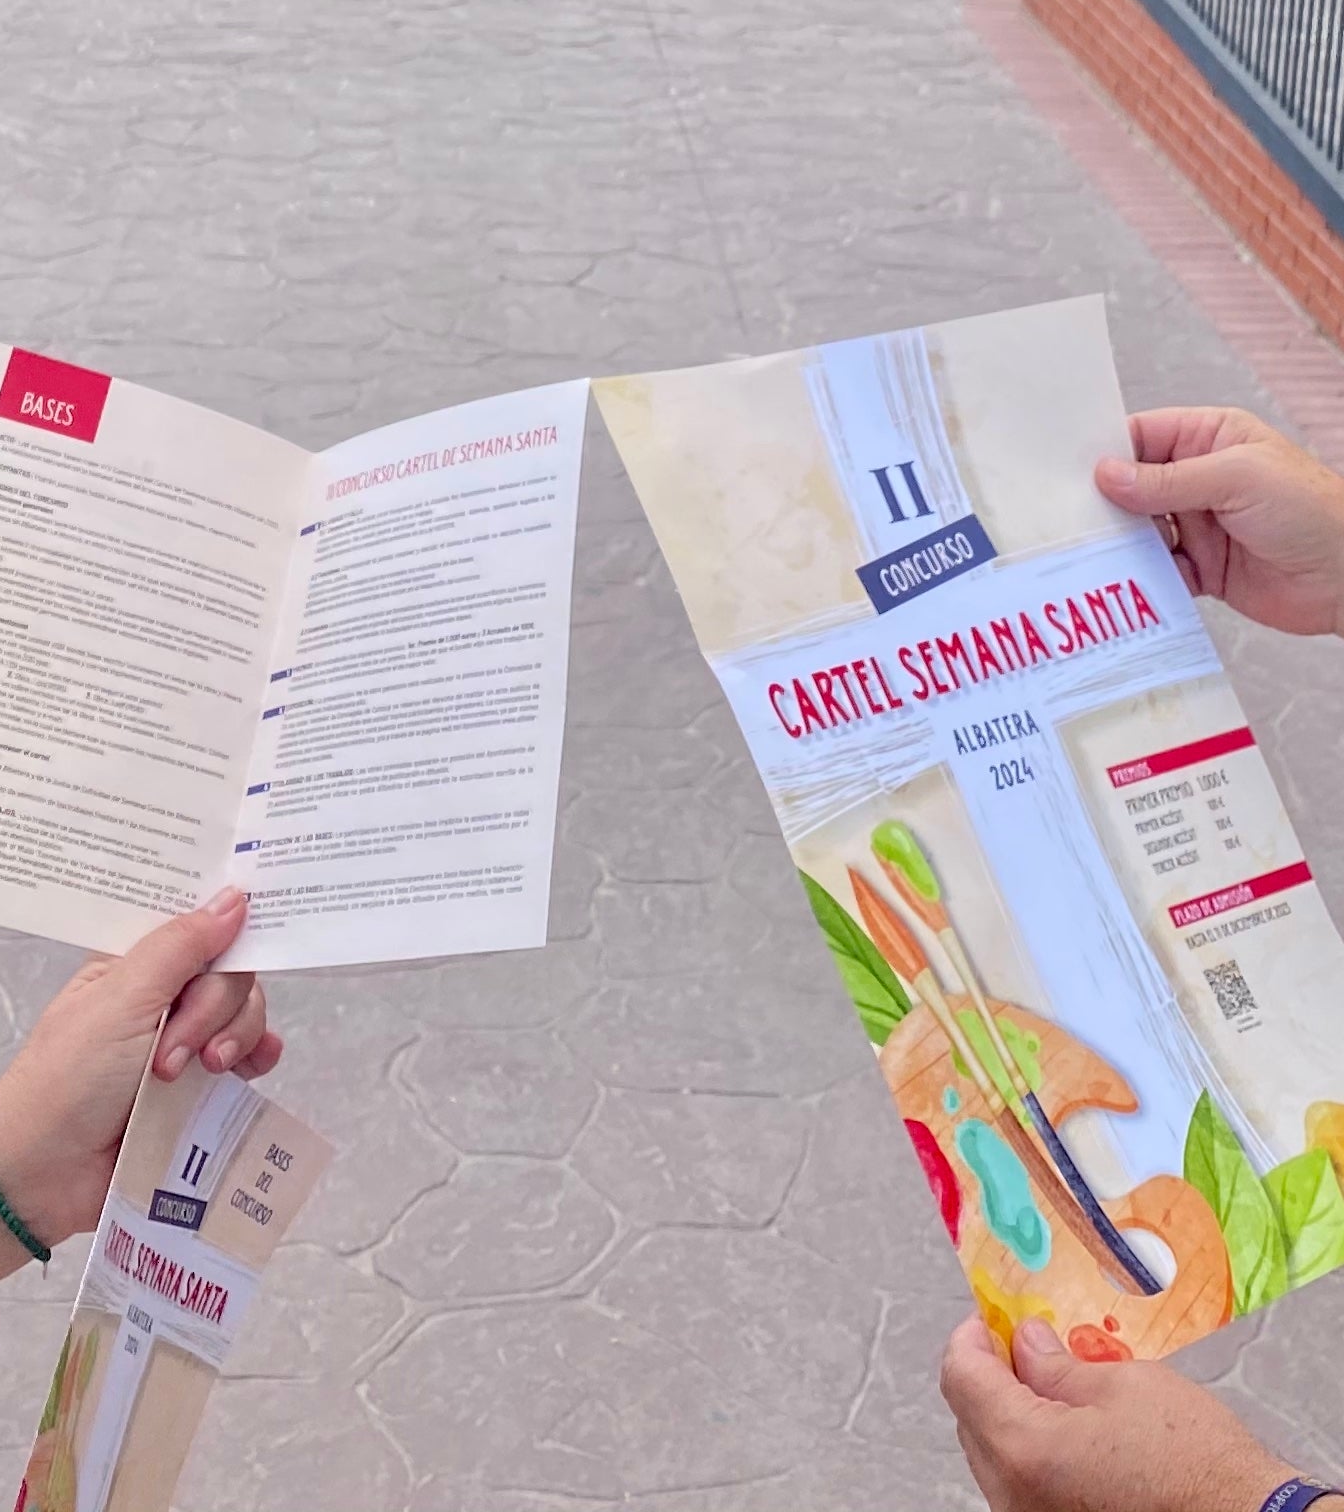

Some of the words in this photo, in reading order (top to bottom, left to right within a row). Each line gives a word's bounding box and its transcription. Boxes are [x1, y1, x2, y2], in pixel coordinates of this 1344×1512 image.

[19, 390, 76, 428] BASES
[396, 451, 439, 480] CARTEL
[441, 446, 458, 468] DE
[458, 434, 512, 465] SEMANA
[515, 426, 558, 452] SANTA
[869, 460, 935, 524] II
[879, 532, 975, 597] CONCURSO
[768, 656, 904, 739] CARTEL
[898, 611, 1053, 701] SEMANA
[1044, 578, 1161, 654] SANTA
[953, 710, 1040, 755] ALBATERA
[989, 759, 1035, 791] 2024
[1125, 790, 1161, 816] PRIMER
[1158, 781, 1194, 806] PREMIO
[1173, 902, 1203, 926] PLAZO
[180, 1143, 210, 1187] II
[264, 1143, 294, 1172] BASES
[255, 1170, 274, 1194] DEL
[155, 1195, 198, 1226] CONCURSO
[230, 1188, 274, 1226] CONCURSO
[132, 1242, 185, 1302] SEMANA
[180, 1271, 229, 1325] SANTA
